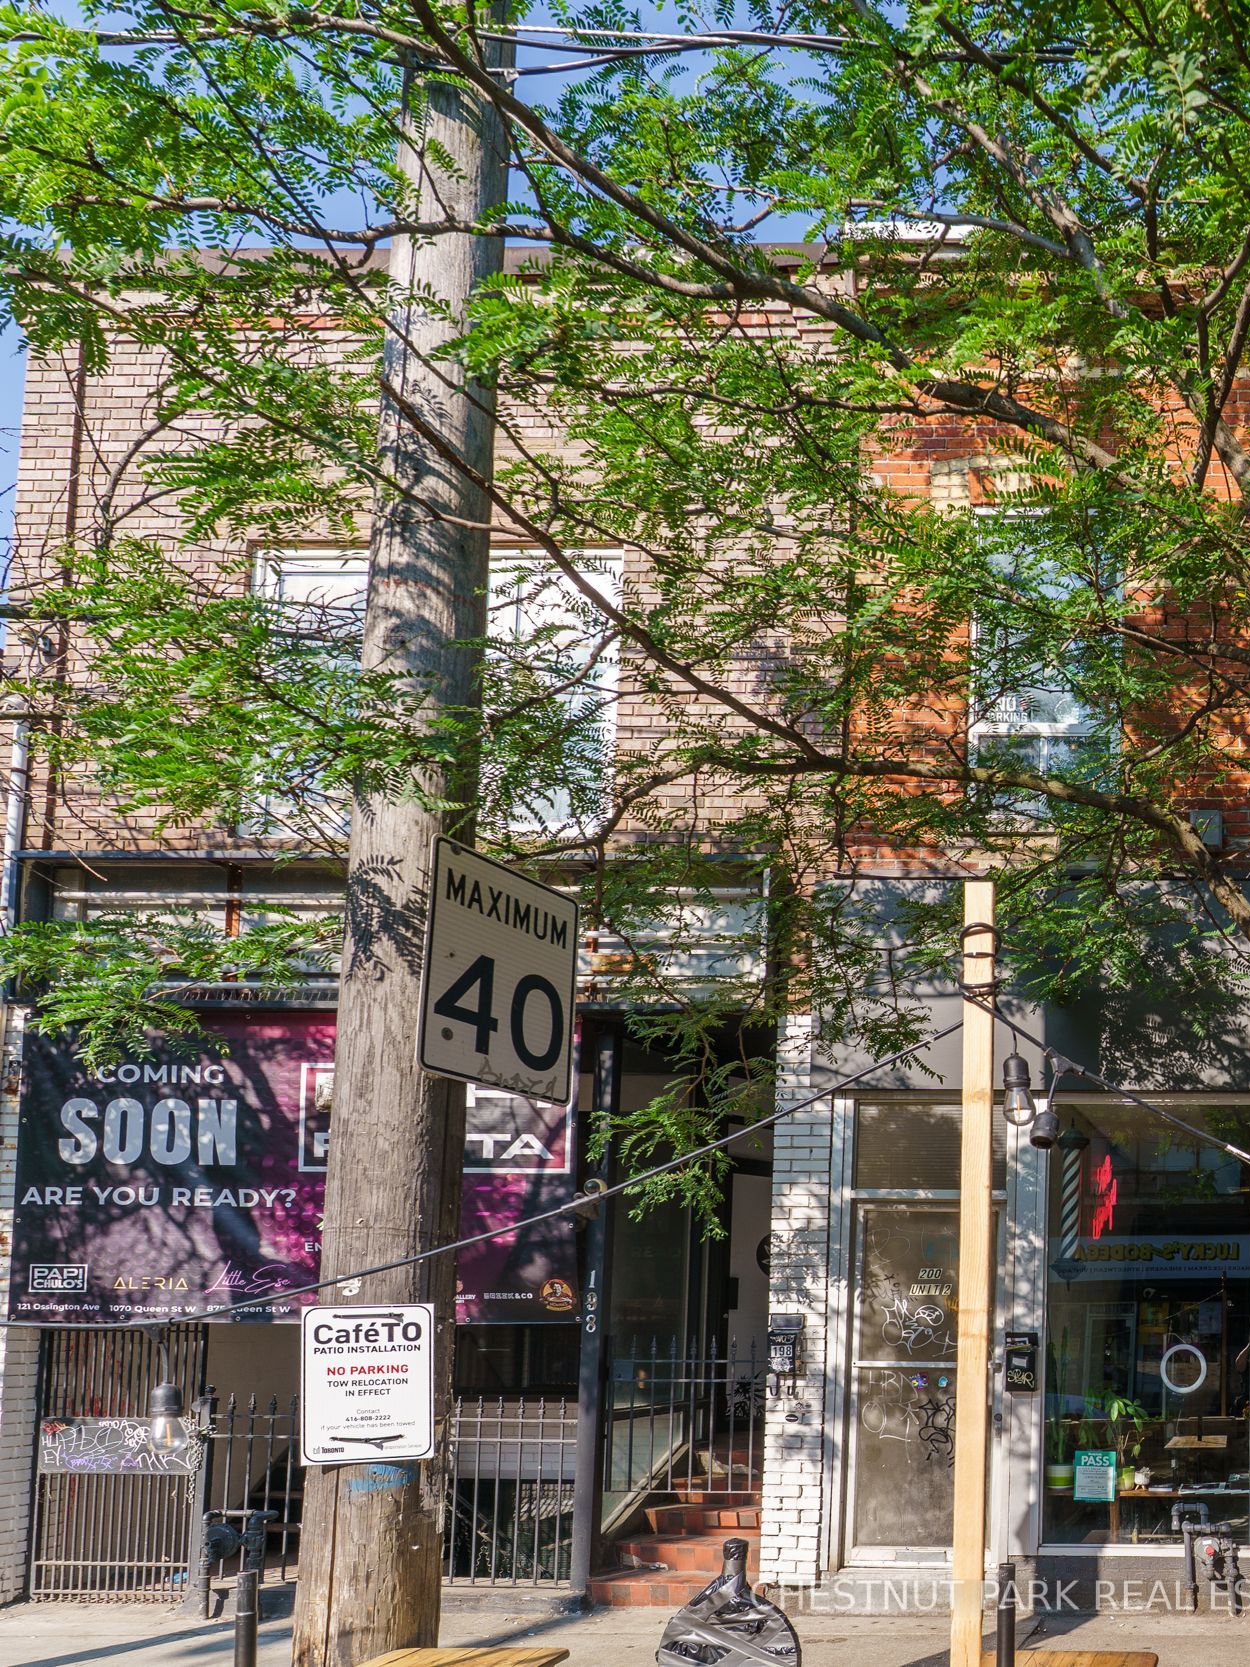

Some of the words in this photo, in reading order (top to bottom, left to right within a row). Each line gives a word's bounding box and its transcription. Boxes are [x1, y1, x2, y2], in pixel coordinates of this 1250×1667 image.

[446, 867, 568, 949] MAXIMUM
[434, 954, 564, 1072] 40
[98, 1064, 225, 1085] COMING
[58, 1097, 238, 1167] SOON
[20, 1186, 83, 1206] ARE
[93, 1186, 160, 1206] YOU
[171, 1187, 297, 1209] READY?
[34, 1268, 84, 1279] PAPI
[205, 1260, 246, 1294] Little
[919, 1269, 942, 1279] 200
[33, 1278, 84, 1289] CHULO'S
[114, 1277, 189, 1290] ALERIA
[911, 1284, 940, 1294] UNIT
[943, 1284, 952, 1294] 2
[17, 1303, 30, 1312] 121
[32, 1303, 81, 1313] Ossington
[82, 1303, 100, 1312] Ave
[110, 1304, 132, 1312] 1070
[134, 1304, 168, 1313] Queen
[171, 1304, 183, 1313] St
[184, 1305, 197, 1313] W
[265, 1305, 276, 1313] St
[279, 1305, 290, 1313] W
[313, 1322, 422, 1345] CaféTO
[314, 1346, 344, 1355] PATIO
[347, 1344, 421, 1354] INSTALLATION
[771, 1345, 793, 1356] 198
[327, 1367, 345, 1376] NO
[350, 1364, 409, 1375] PARKING
[327, 1380, 349, 1388] TOW
[351, 1378, 408, 1387] RELOCATION
[345, 1389, 355, 1397] IN
[358, 1388, 391, 1396] EFFECT
[321, 1446, 345, 1454] TORONTO
[1081, 1455, 1110, 1466] PASS
